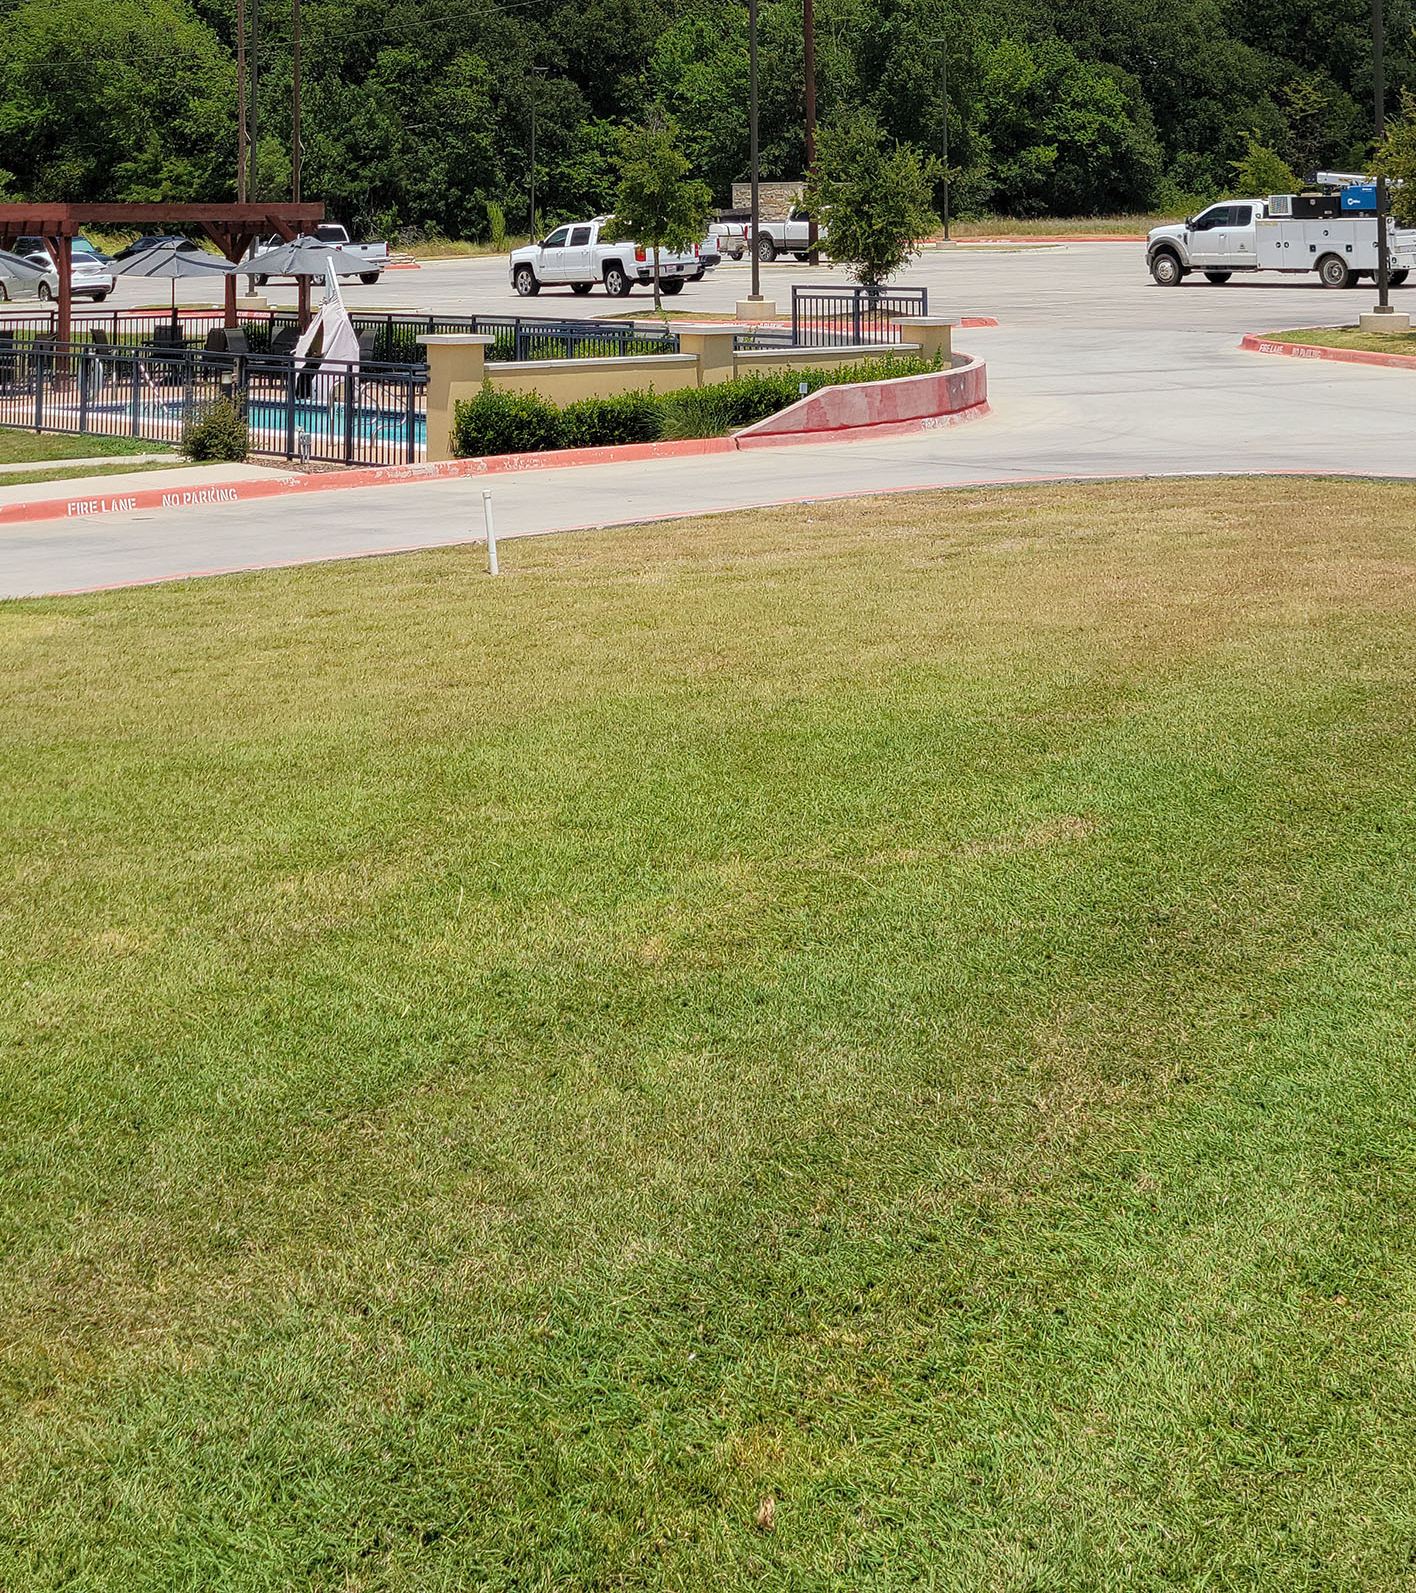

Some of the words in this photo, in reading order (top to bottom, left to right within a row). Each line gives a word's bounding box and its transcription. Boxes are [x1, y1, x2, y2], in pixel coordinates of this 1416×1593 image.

[67, 499, 98, 516] FIRE
[101, 498, 137, 513] LANE
[162, 493, 180, 507] NO
[183, 487, 238, 504] PARKING
